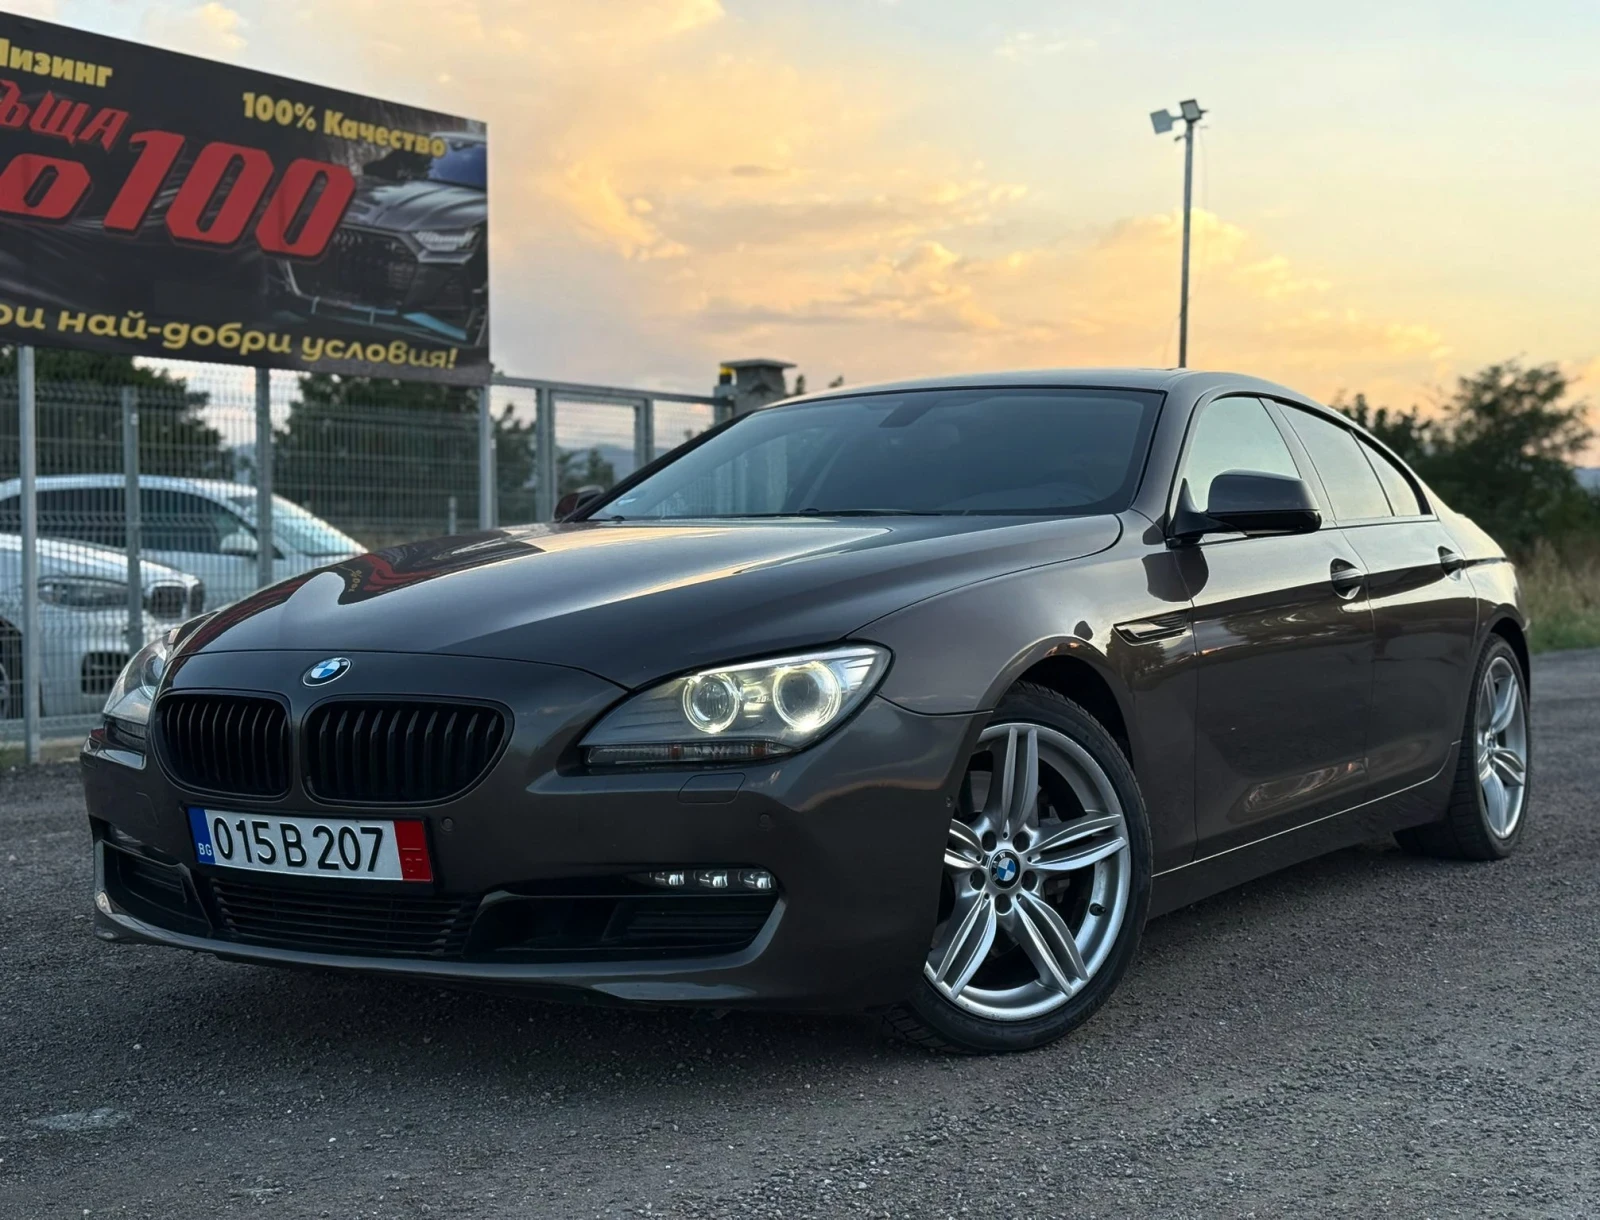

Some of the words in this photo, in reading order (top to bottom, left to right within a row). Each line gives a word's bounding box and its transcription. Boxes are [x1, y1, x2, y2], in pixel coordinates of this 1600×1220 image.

[242, 92, 317, 131] 100%
[323, 109, 447, 158] Качество
[57, 310, 292, 356] най-добри
[301, 336, 458, 370] условия!
[197, 842, 213, 857] BG
